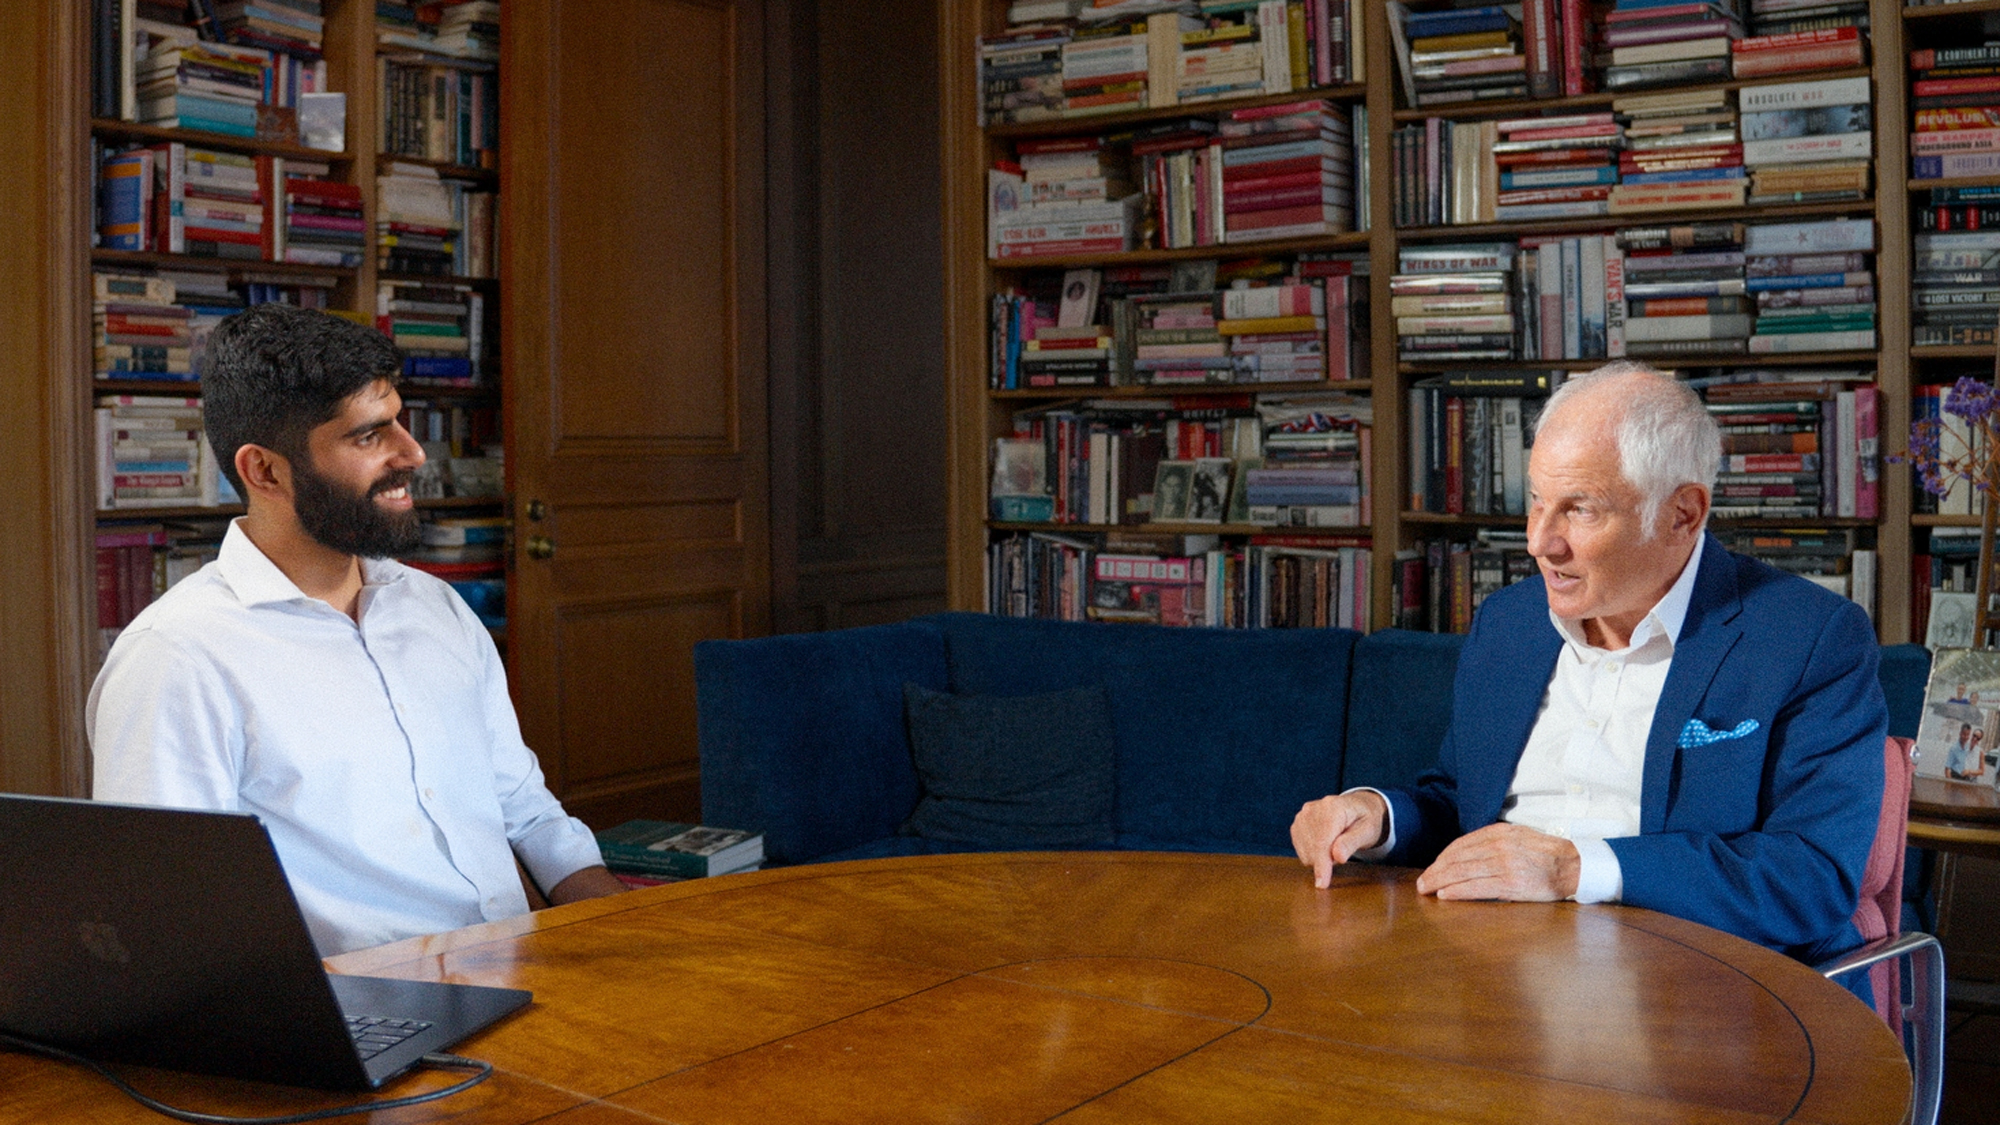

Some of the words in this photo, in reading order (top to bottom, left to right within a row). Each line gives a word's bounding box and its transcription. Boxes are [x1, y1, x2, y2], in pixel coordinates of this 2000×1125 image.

[1406, 260, 1445, 271] WINGS
[1449, 258, 1465, 270] OF
[1470, 257, 1498, 268] WAR
[1954, 272, 1982, 282] WAR
[1932, 294, 1950, 303] LOST
[1951, 293, 1984, 303] VICTORY
[1608, 301, 1623, 329] WAR
